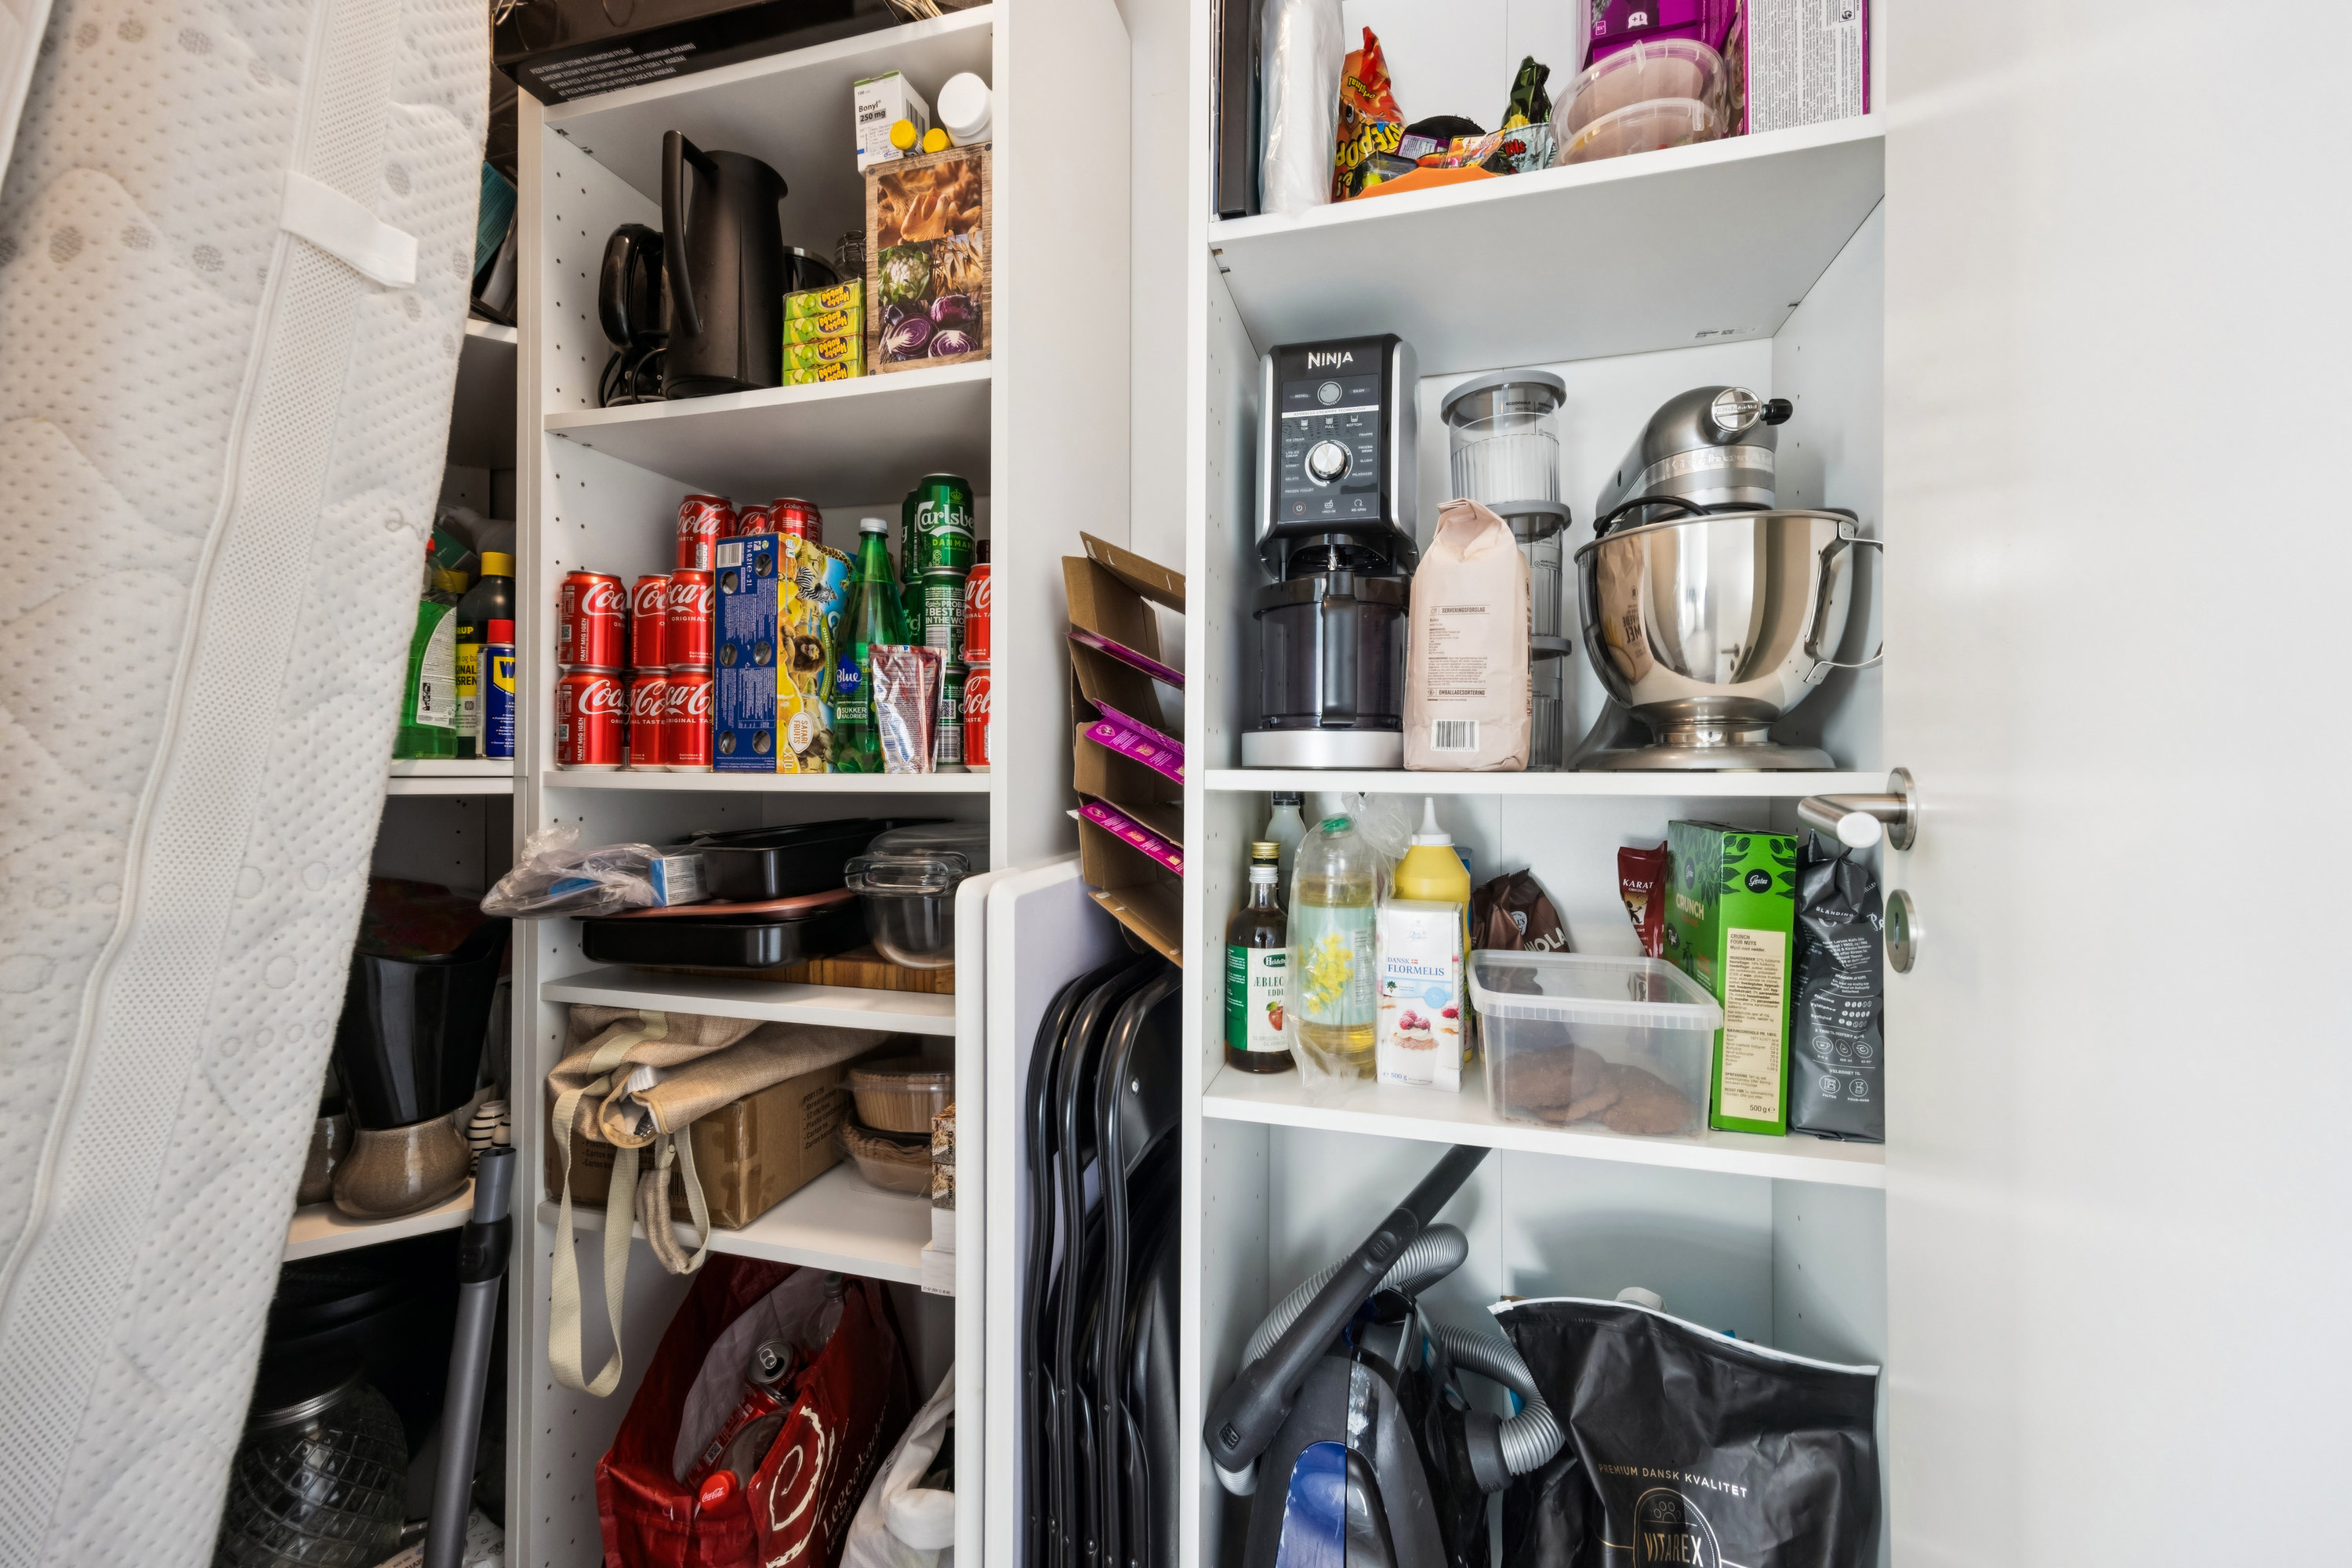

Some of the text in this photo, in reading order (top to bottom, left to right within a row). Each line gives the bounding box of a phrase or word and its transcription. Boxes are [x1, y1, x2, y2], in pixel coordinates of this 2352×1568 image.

[1348, 77, 1377, 100] original
[860, 113, 873, 122] 250
[821, 285, 844, 303] Bubba
[827, 291, 850, 307] Hubba
[818, 310, 841, 326] Bubba
[825, 315, 848, 331] Hubba
[818, 336, 840, 353] Bubba
[825, 342, 848, 358] Hubba
[1308, 351, 1354, 369] NINJA
[818, 362, 840, 379] Bubba
[916, 500, 974, 532] Carlsbe
[822, 627, 830, 648] OHNE
[836, 668, 862, 684] Blue
[837, 707, 841, 720] 0
[783, 751, 793, 769] x10
[1623, 878, 1654, 889] KARAT
[1675, 893, 1704, 920] CRUNCH
[1816, 906, 1854, 918] BLANDING
[1388, 964, 1445, 977] FLORMELIS
[1254, 976, 1284, 987] ÆBLEC
[1598, 1463, 1748, 1497] PREMIUM DANSK KVALITET
[701, 1486, 725, 1504] Coca-Cola
[1644, 1532, 1704, 1567] VITAREX
